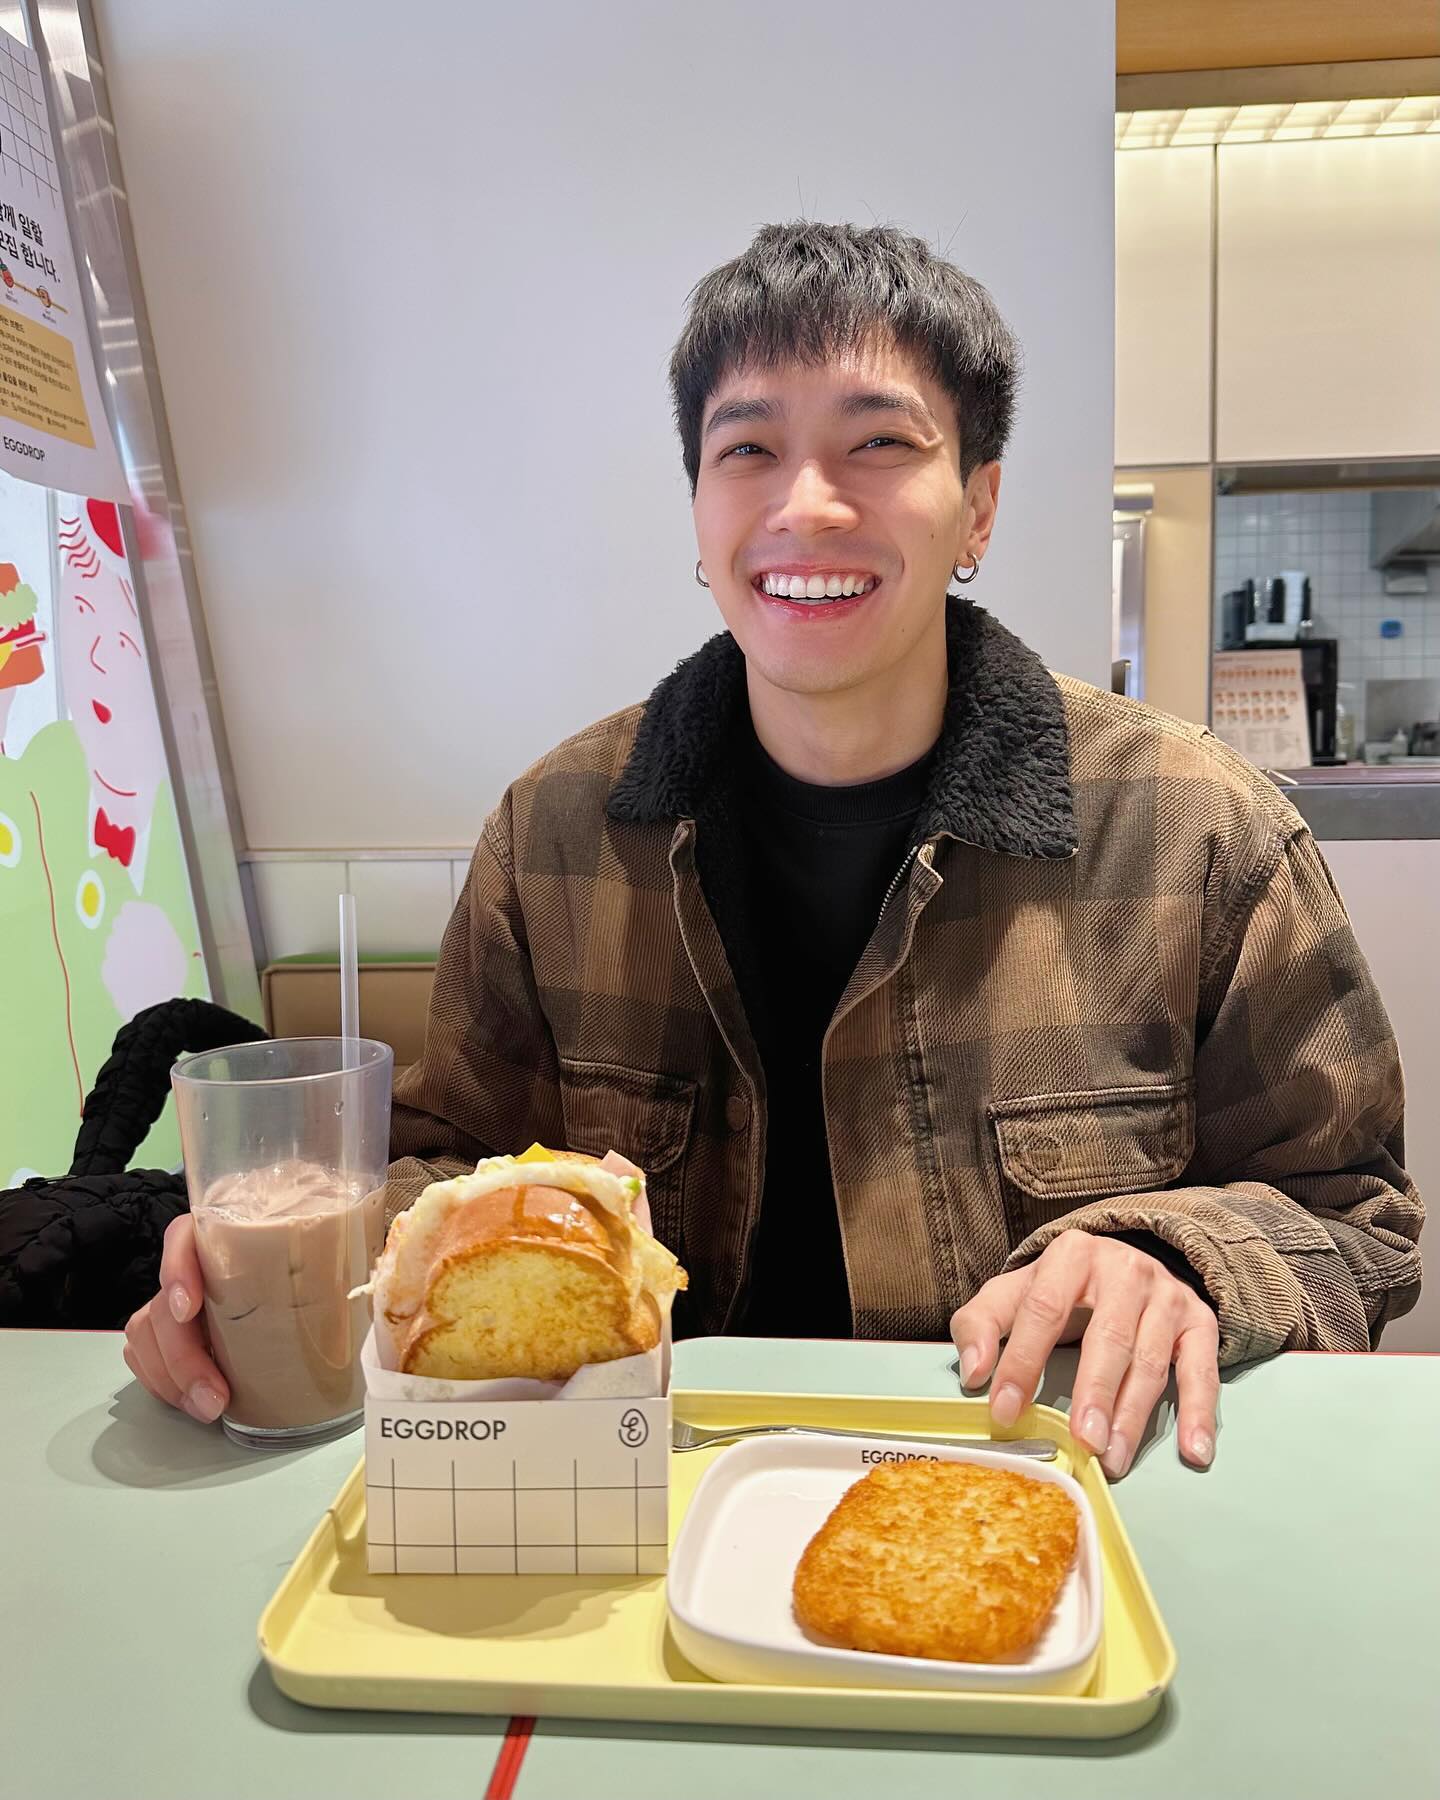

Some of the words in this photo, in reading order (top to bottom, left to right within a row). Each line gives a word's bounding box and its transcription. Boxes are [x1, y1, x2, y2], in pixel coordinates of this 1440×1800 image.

[18, 213, 44, 247] 일할
[20, 242, 61, 283] 합니다.
[3, 436, 45, 461] EGGDROP
[380, 1417, 506, 1441] EGGDROP
